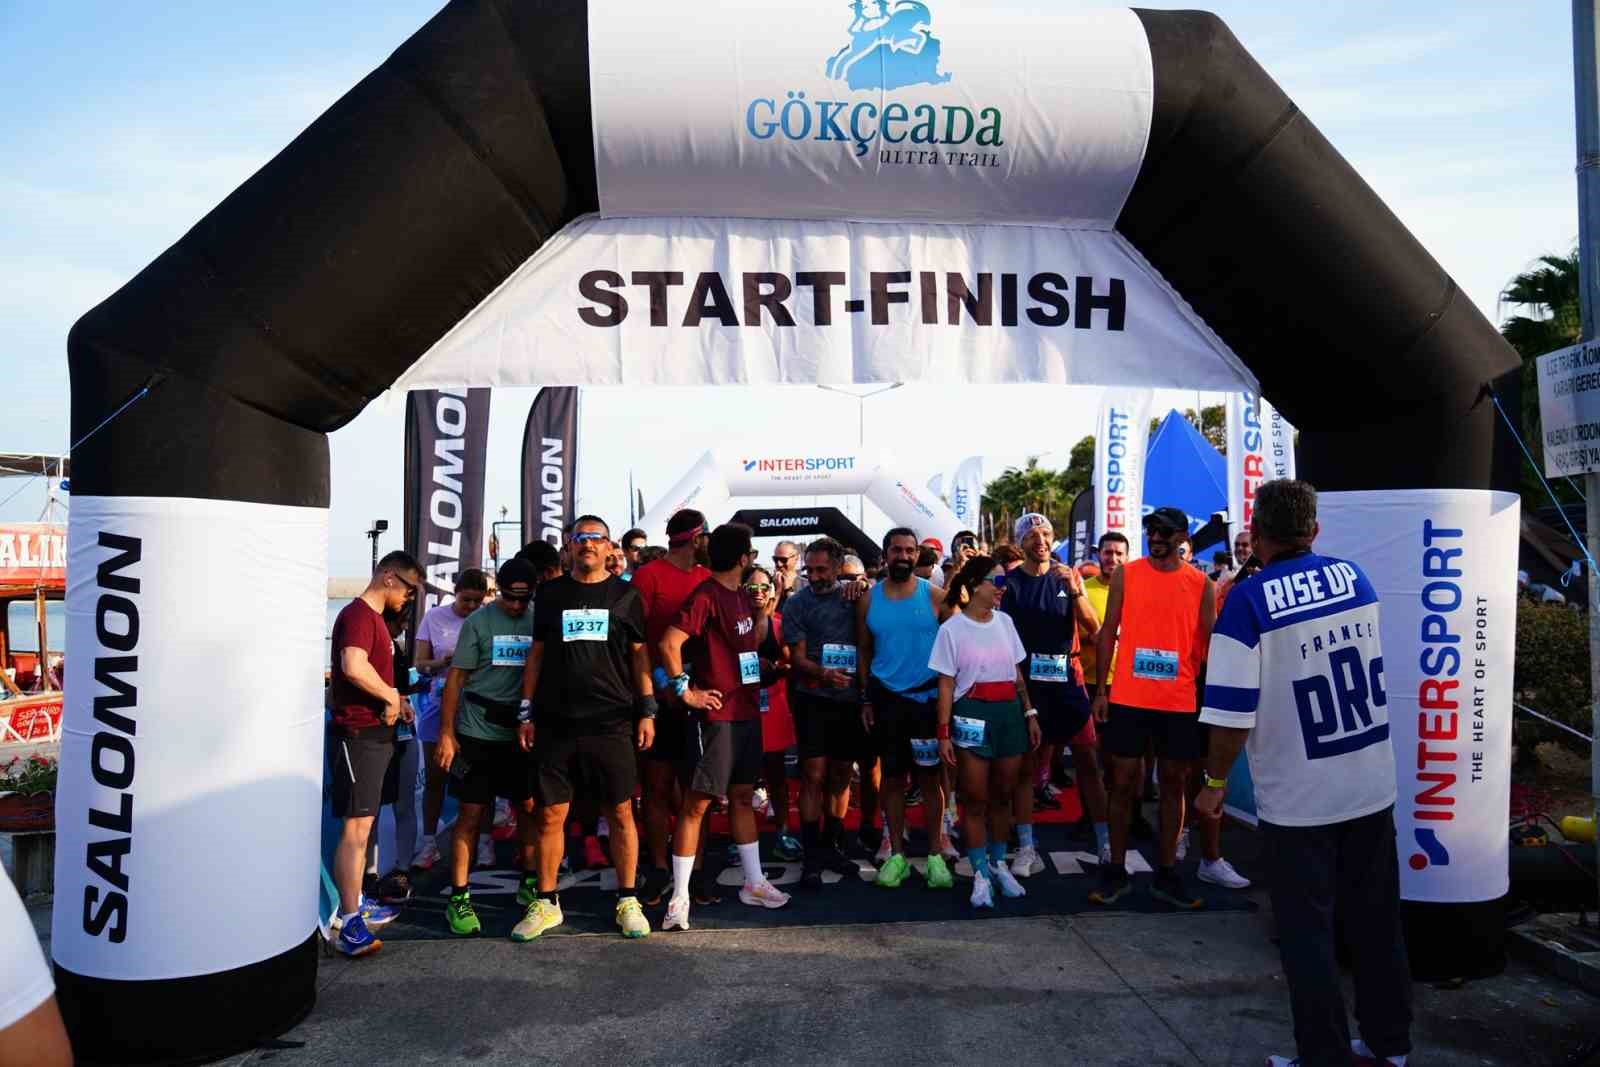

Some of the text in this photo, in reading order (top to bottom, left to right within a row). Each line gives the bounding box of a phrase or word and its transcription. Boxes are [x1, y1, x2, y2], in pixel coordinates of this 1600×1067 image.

[577, 269, 1127, 332] START-FINISH
[1271, 407, 1282, 437] SPO
[758, 456, 856, 472] INTERSPORT
[1106, 407, 1129, 533] ERSPORT
[759, 516, 819, 528] SALOMON
[1262, 562, 1358, 613] RISE UP
[567, 621, 605, 633] 1237
[743, 663, 759, 676] 12
[1138, 660, 1175, 673] 1093
[1412, 518, 1464, 822] INTERSPORT
[1471, 596, 1489, 784] THE HEART OF SPORT
[82, 531, 143, 944] SALOMON
